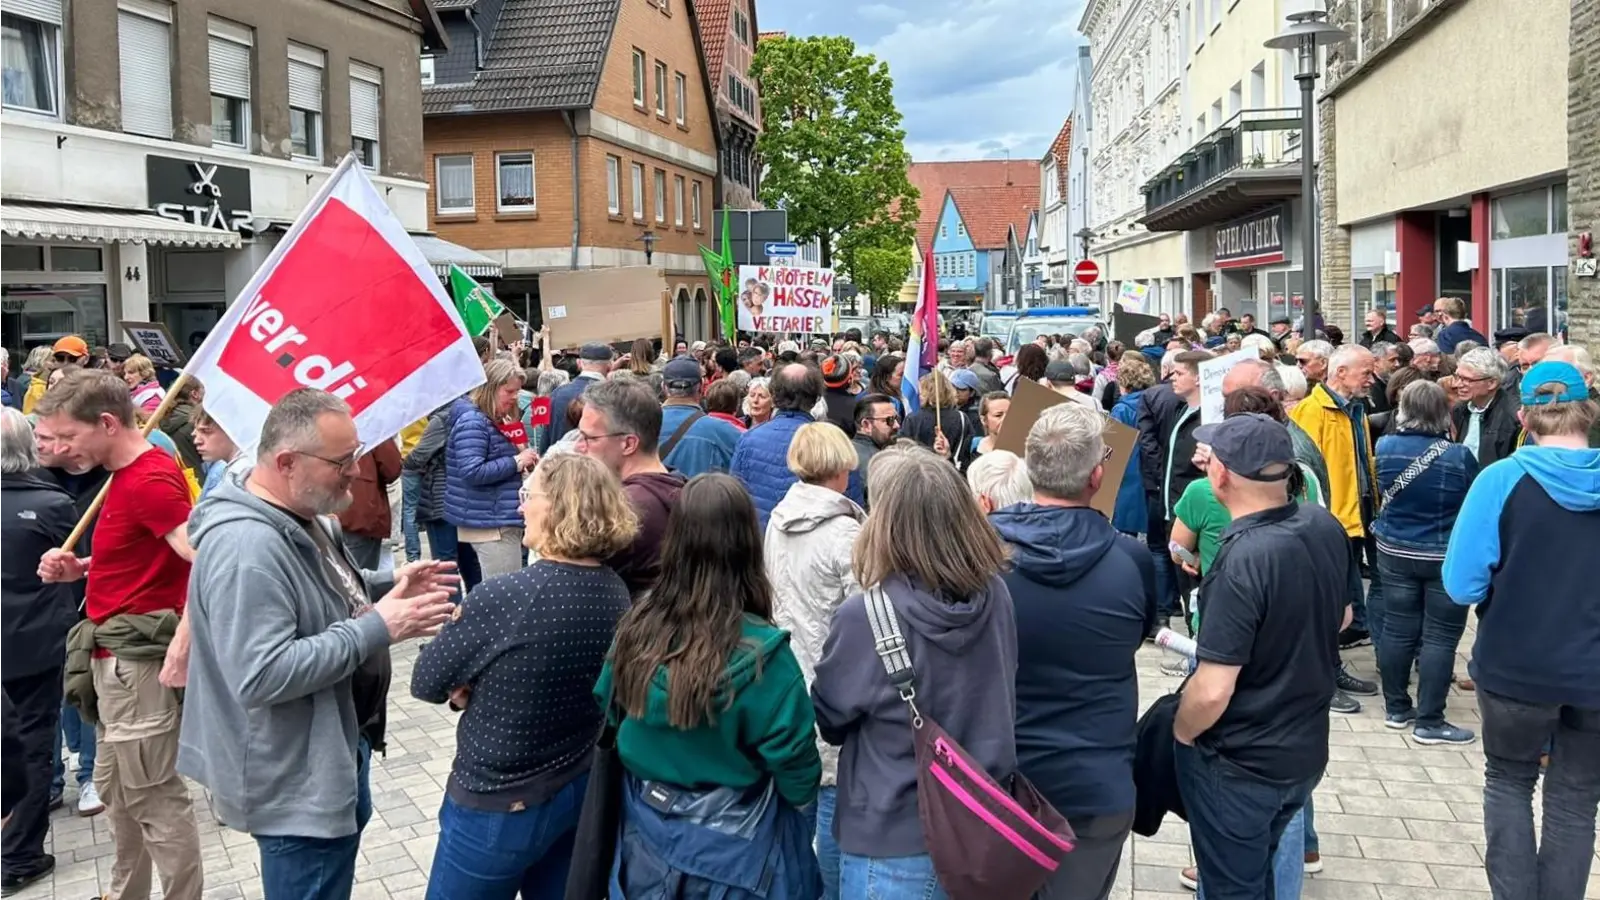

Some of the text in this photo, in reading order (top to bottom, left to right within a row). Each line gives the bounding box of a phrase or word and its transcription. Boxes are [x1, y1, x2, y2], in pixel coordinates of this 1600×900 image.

[157, 199, 254, 231] STAR
[1216, 215, 1280, 256] SPIELOTHEK
[125, 266, 140, 281] 44
[758, 266, 832, 287] KARTOFFELN
[773, 286, 831, 309] HASSEN
[752, 316, 823, 332] VEGETARIER
